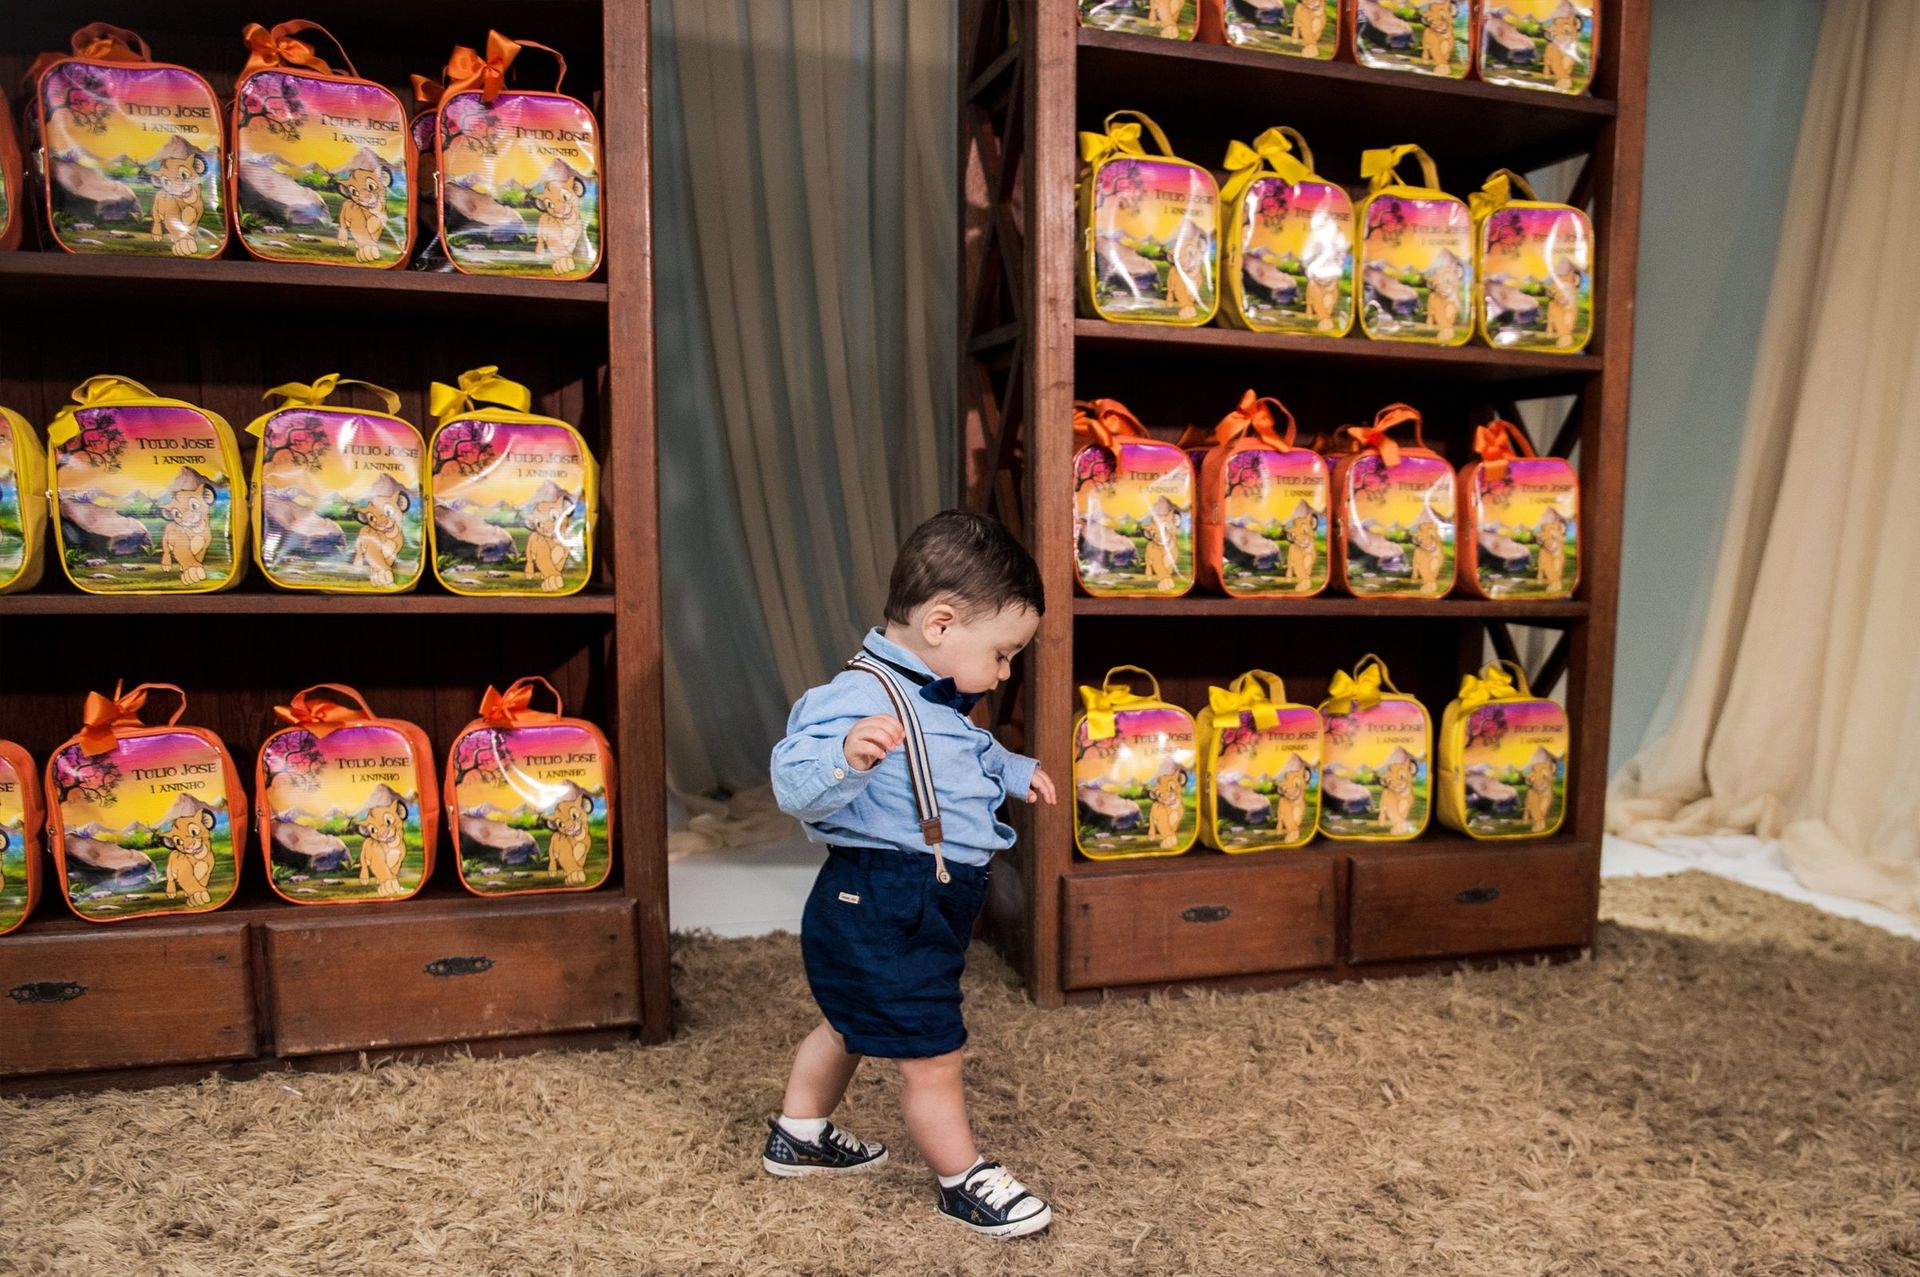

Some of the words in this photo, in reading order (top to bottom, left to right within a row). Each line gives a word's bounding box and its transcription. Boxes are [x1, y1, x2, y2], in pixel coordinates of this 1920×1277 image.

[126, 102, 171, 117] TULIO
[174, 104, 211, 118] JOSE
[365, 118, 400, 132] JOSE
[557, 129, 591, 142] JOSE
[136, 437, 179, 450] TULIO
[181, 437, 216, 449] JOSE
[384, 445, 419, 459] JOSE
[162, 455, 207, 465] ANINHO
[363, 462, 406, 472] ANINHO
[336, 757, 377, 769] TULIO
[379, 756, 410, 768] JOSE
[523, 754, 563, 767] TULIO
[566, 752, 597, 764] JOSE
[132, 767, 178, 781] TULIO
[181, 763, 216, 776] JOSE
[361, 773, 400, 783] ANINHO
[546, 768, 586, 779] ANINHO
[160, 780, 206, 793] ANINHO
